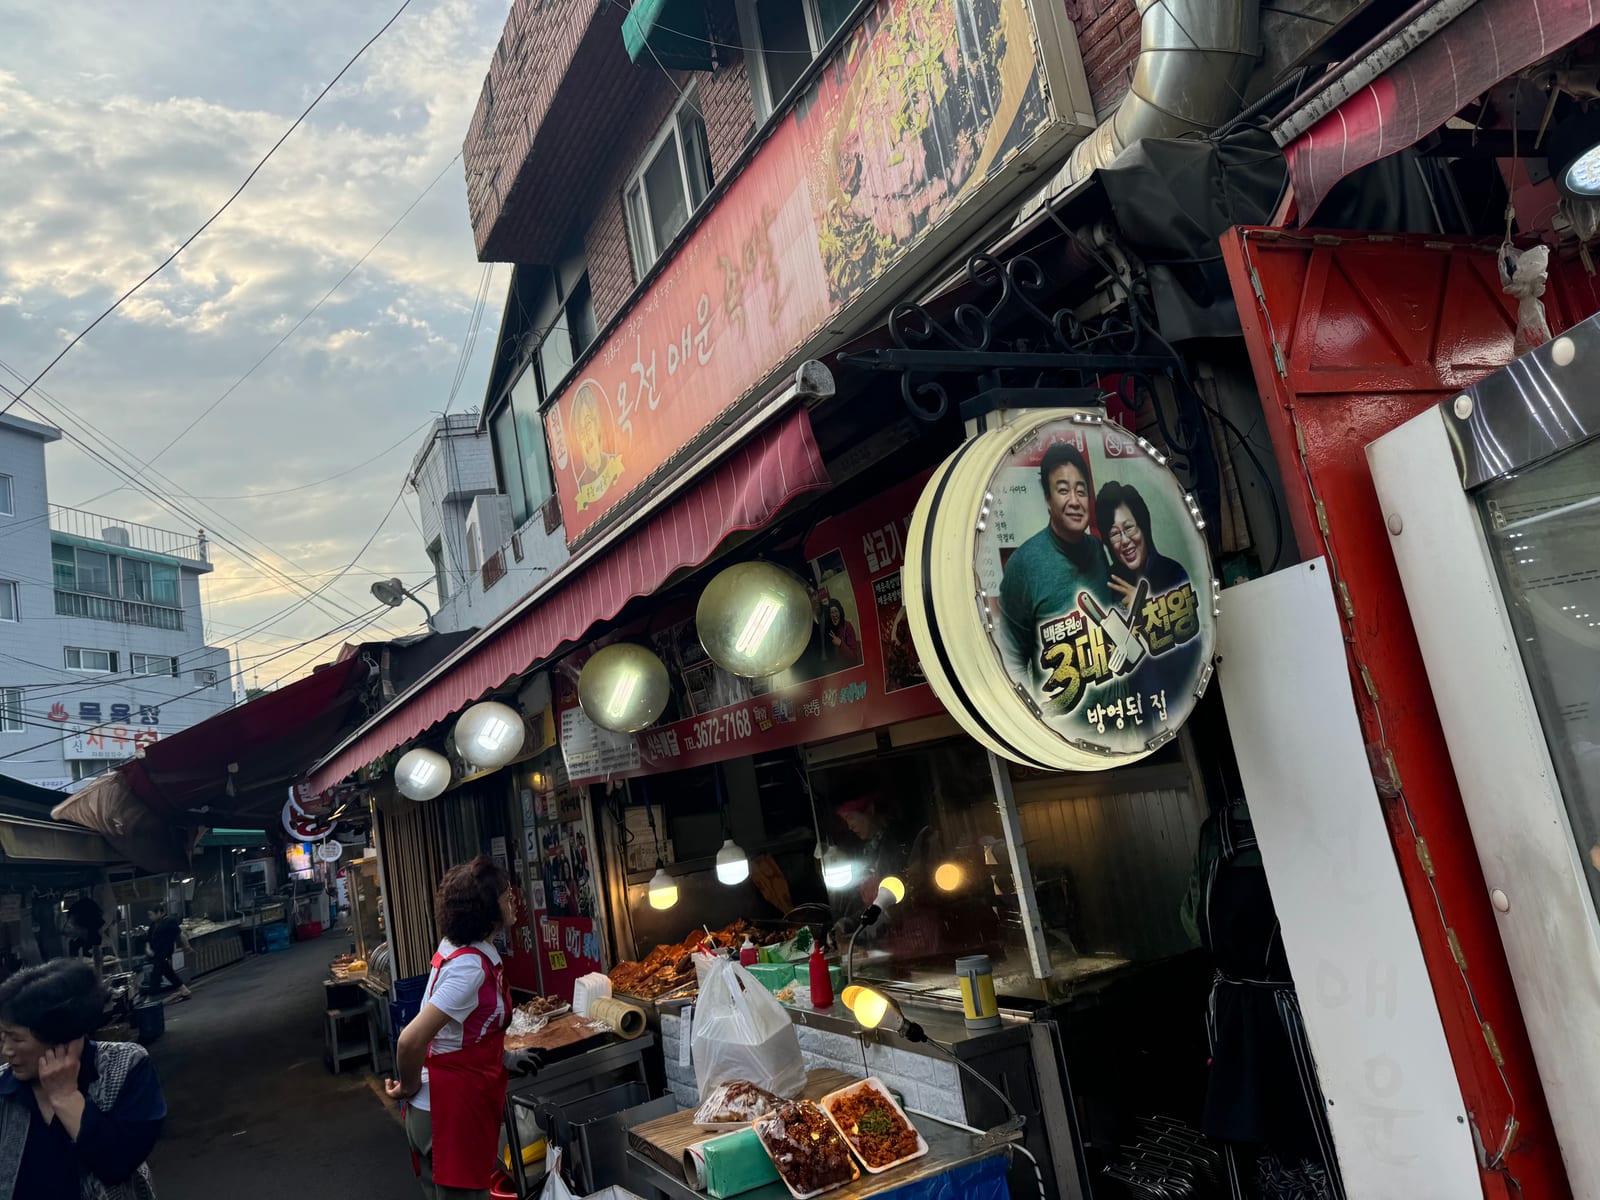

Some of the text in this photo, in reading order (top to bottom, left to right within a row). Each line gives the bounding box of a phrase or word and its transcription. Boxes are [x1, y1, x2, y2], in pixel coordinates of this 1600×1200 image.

[617, 334, 661, 449] 옥천
[667, 293, 717, 377] 매운
[862, 520, 904, 574] 살코기
[1042, 615, 1083, 643] 백종원의
[1044, 583, 1198, 712] 3대 천왕
[79, 702, 161, 726] 목욕탕
[693, 707, 752, 750] 3672-7168
[1087, 689, 1168, 734] 방영된 집
